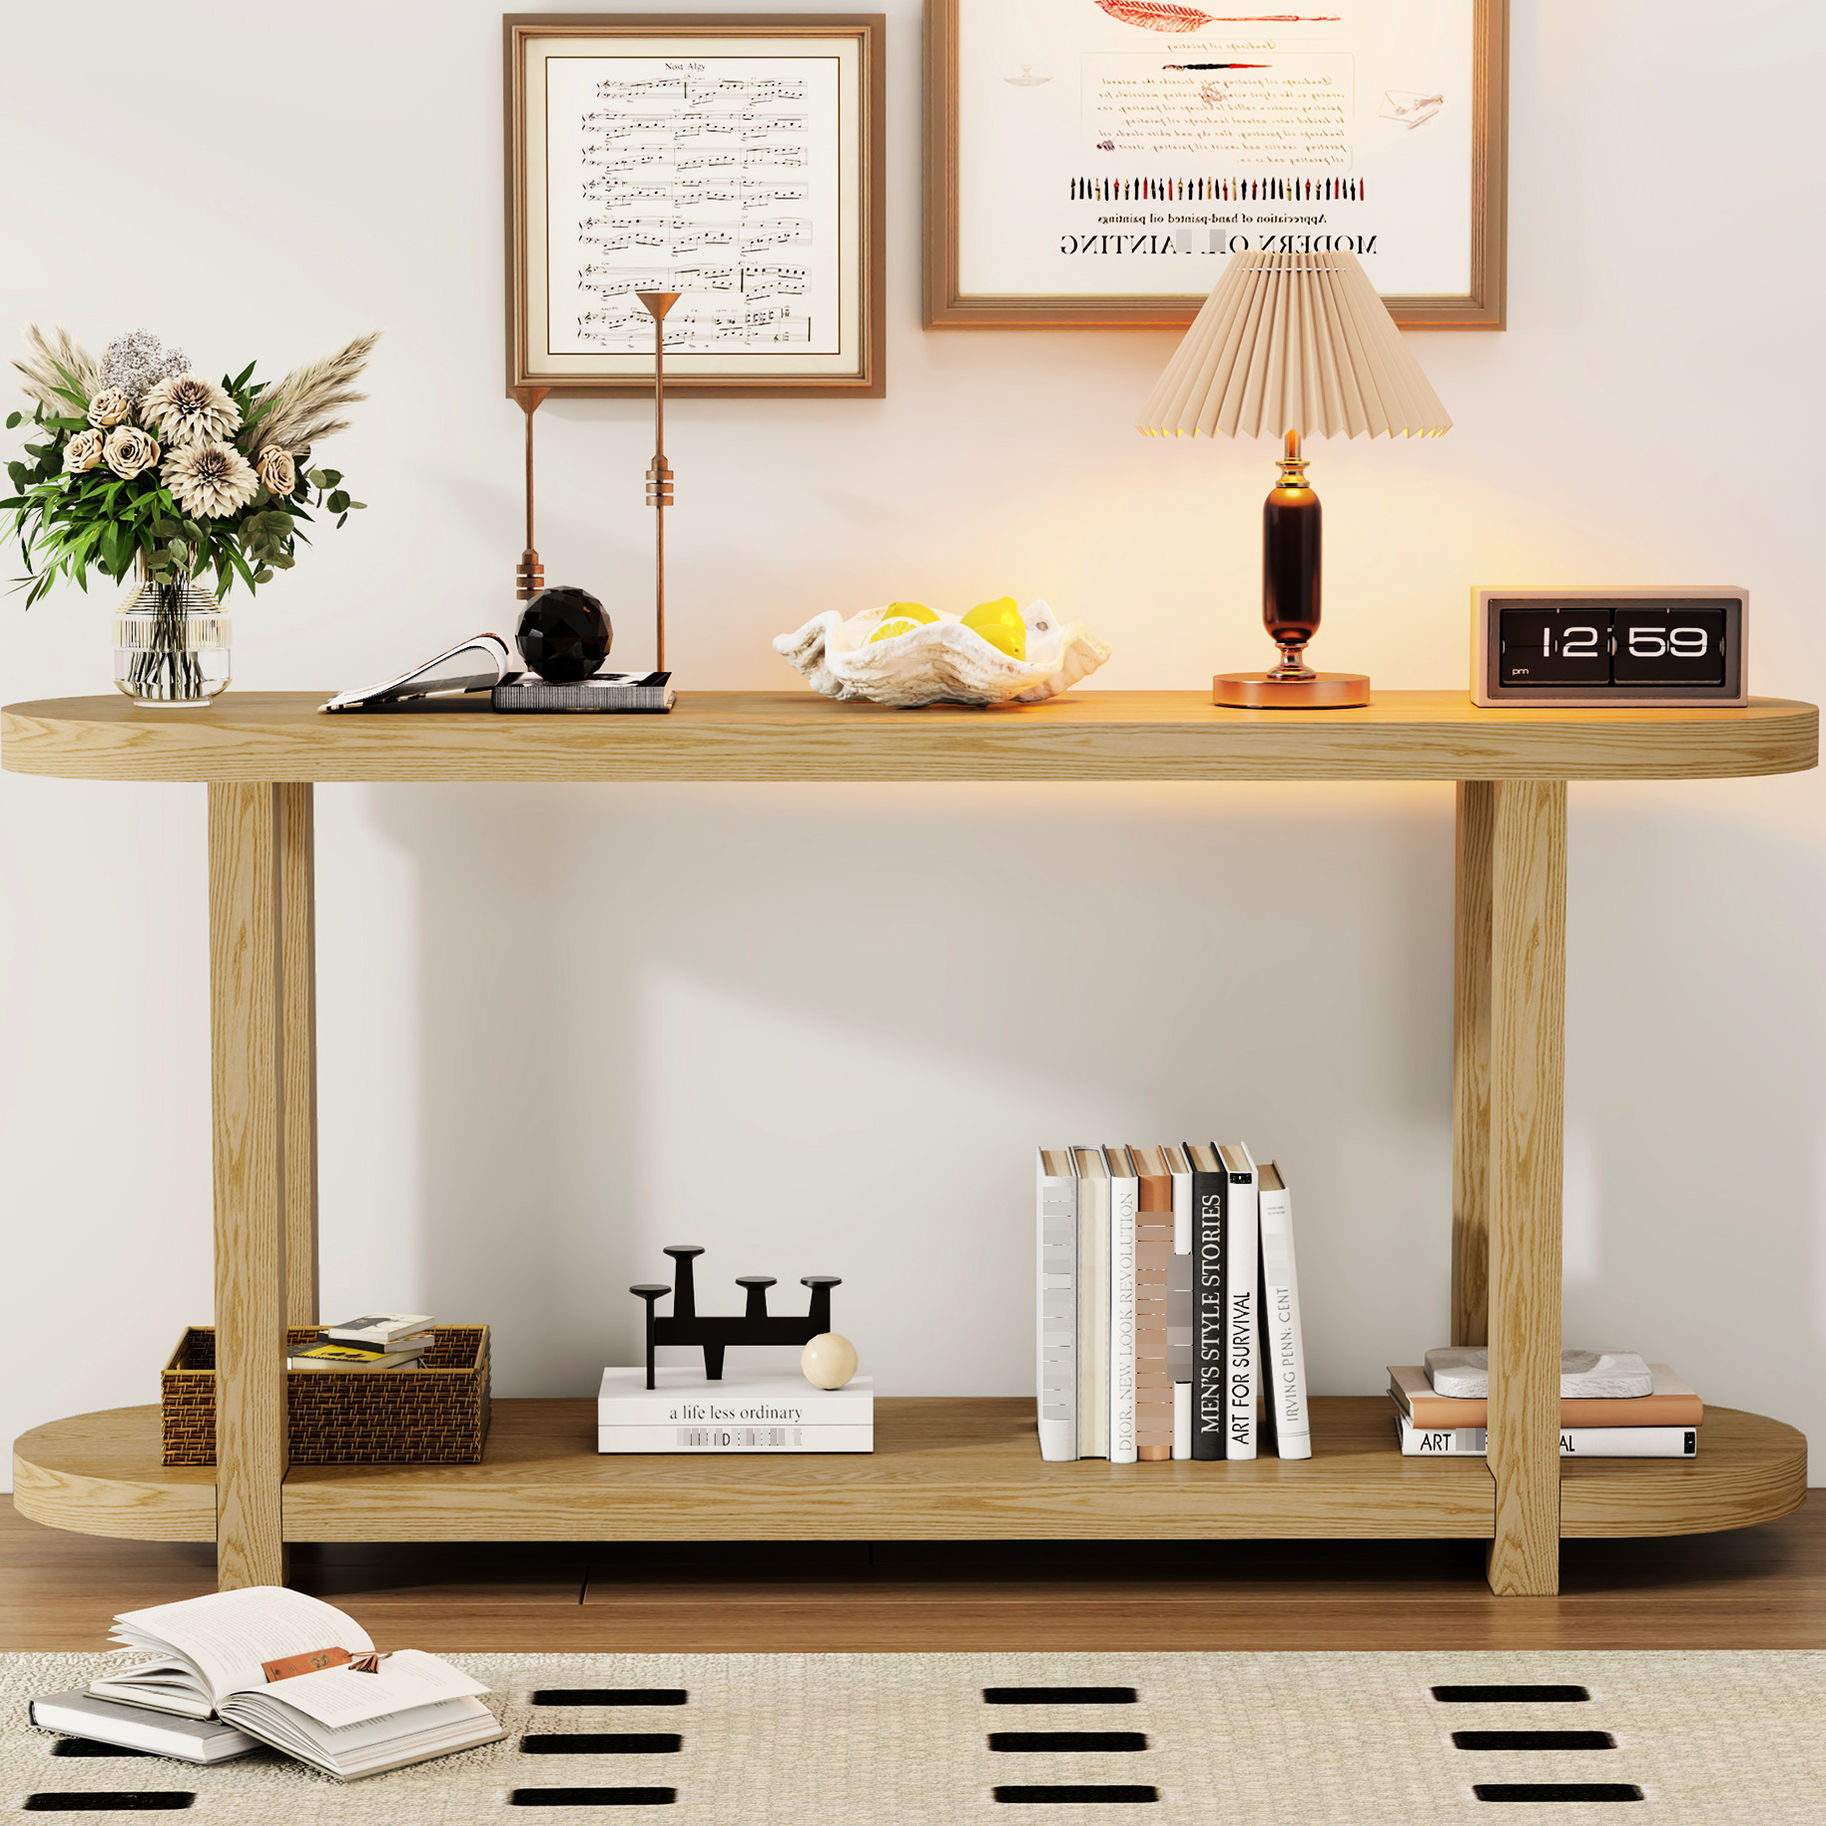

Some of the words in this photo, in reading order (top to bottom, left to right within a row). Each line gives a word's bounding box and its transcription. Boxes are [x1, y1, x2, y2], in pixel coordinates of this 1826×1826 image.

[665, 62, 684, 71] Nost
[688, 62, 706, 73] Algy
[1543, 627, 1598, 657] 12
[1628, 627, 1708, 657] 59
[1119, 1193, 1133, 1304] REVOLUTION
[1201, 1194, 1221, 1287] STORIES
[1119, 1309, 1133, 1356] LOOK
[1200, 1292, 1220, 1361] STYLE
[1232, 1291, 1251, 1368] SURVIVAL
[1279, 1327, 1295, 1367] PENN:
[1119, 1363, 1133, 1401] NEW
[1200, 1366, 1220, 1433] MEN'S
[1231, 1373, 1250, 1407] FOR
[1285, 1371, 1299, 1422] IRVING
[669, 1409, 678, 1420] a
[683, 1404, 706, 1420] life
[710, 1404, 735, 1420] less
[740, 1404, 803, 1423] ordinary
[1119, 1403, 1133, 1451] DIOR.
[1231, 1414, 1250, 1445] ART
[1420, 1433, 1452, 1452] ART
